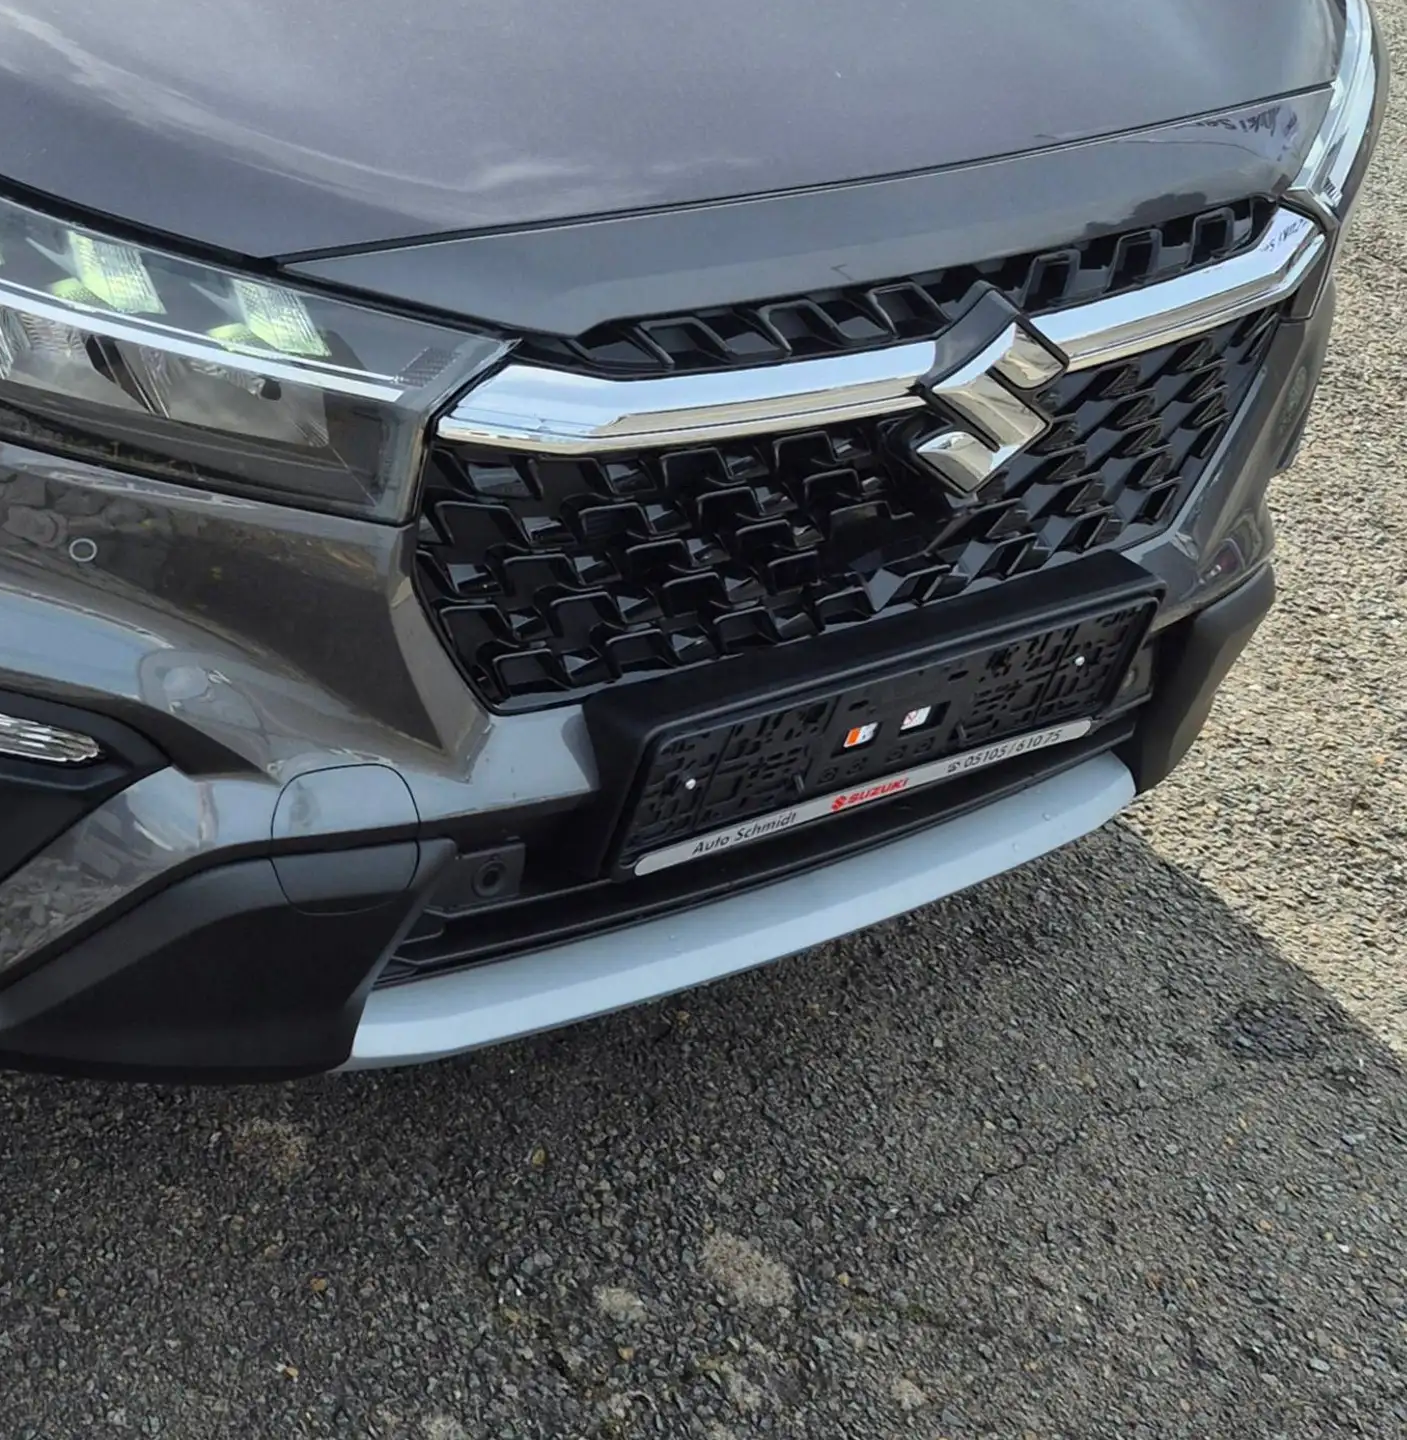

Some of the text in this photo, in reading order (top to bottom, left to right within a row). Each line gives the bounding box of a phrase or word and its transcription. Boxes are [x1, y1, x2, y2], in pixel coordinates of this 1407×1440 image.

[692, 836, 730, 855] Auto
[734, 812, 797, 841] Schmidt
[847, 777, 909, 804] SUZUKI
